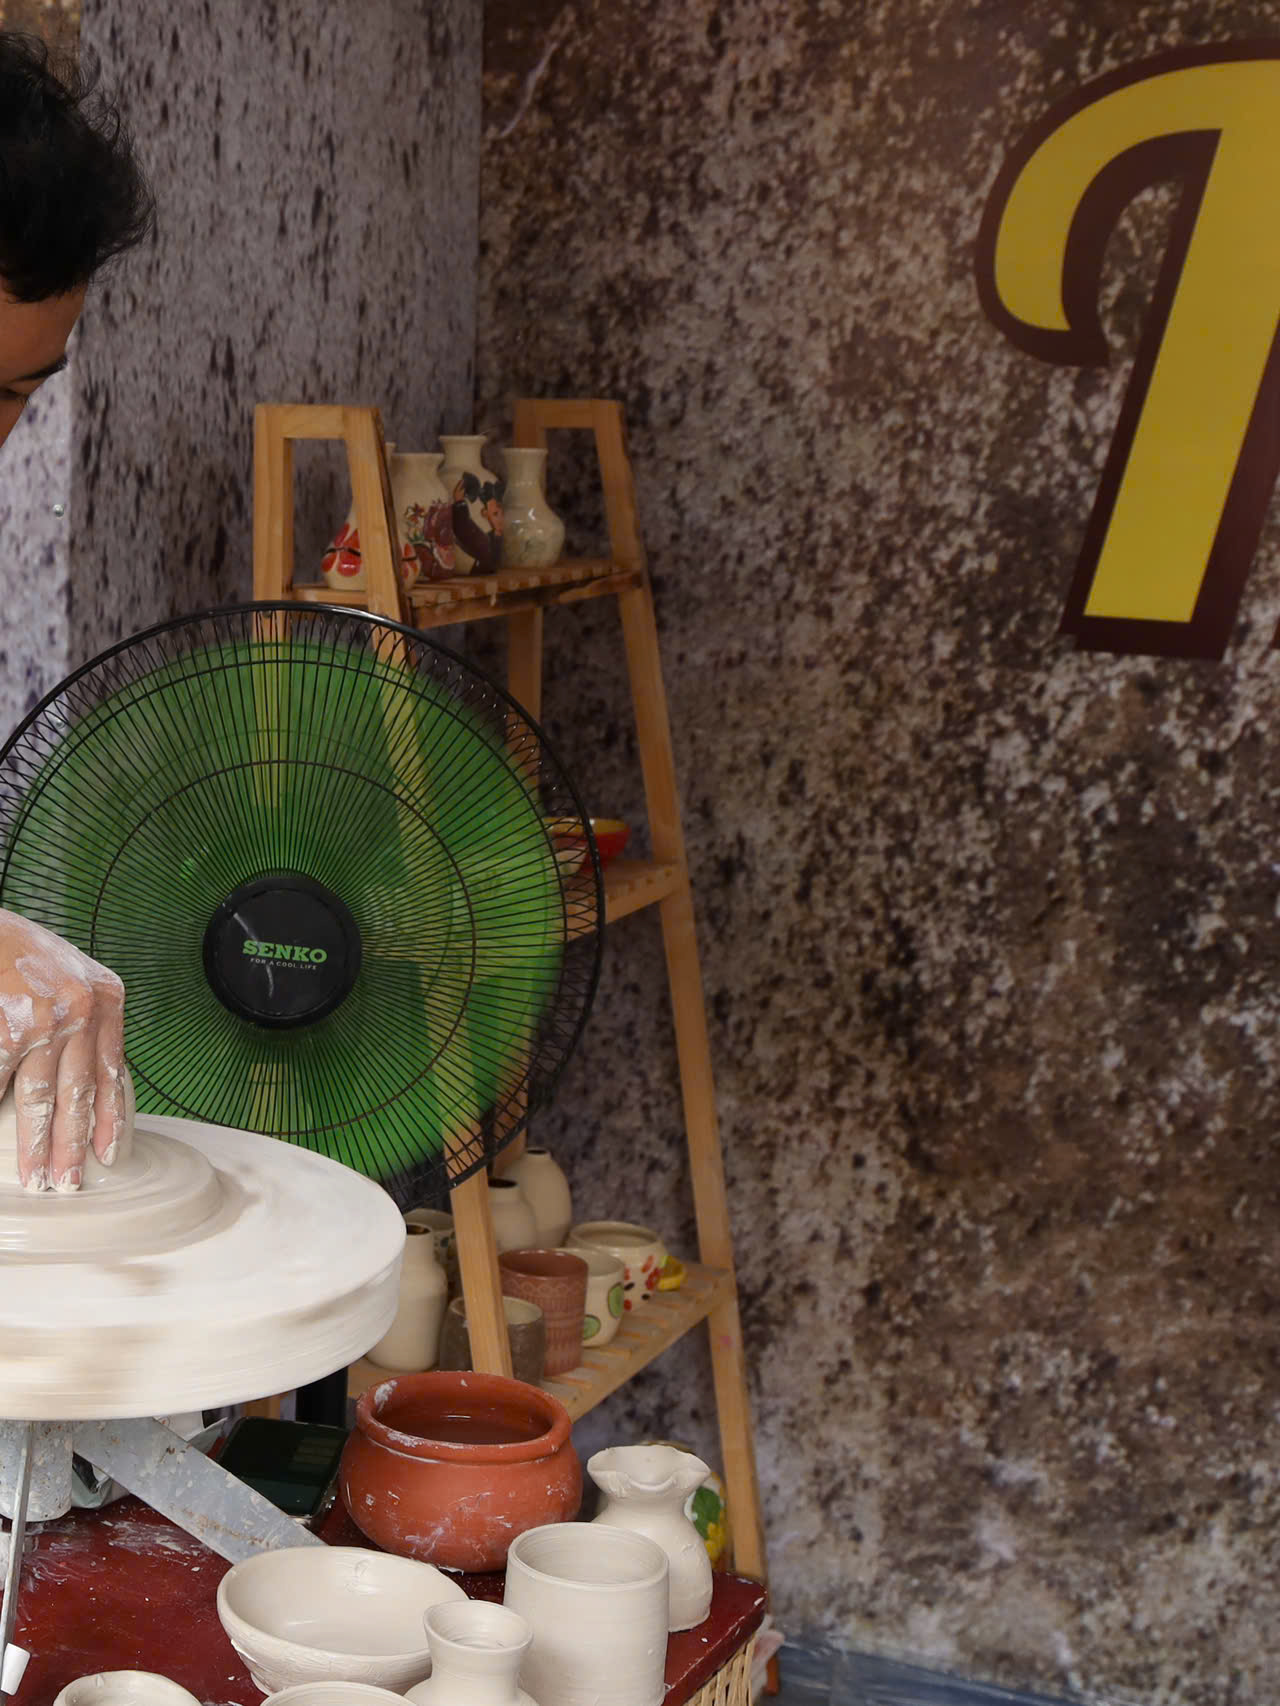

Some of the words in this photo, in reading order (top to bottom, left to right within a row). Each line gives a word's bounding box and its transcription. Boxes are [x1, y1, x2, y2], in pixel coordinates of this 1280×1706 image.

[242, 939, 328, 964] SENKO
[250, 957, 267, 965] FOR
[276, 961, 298, 969] COOL
